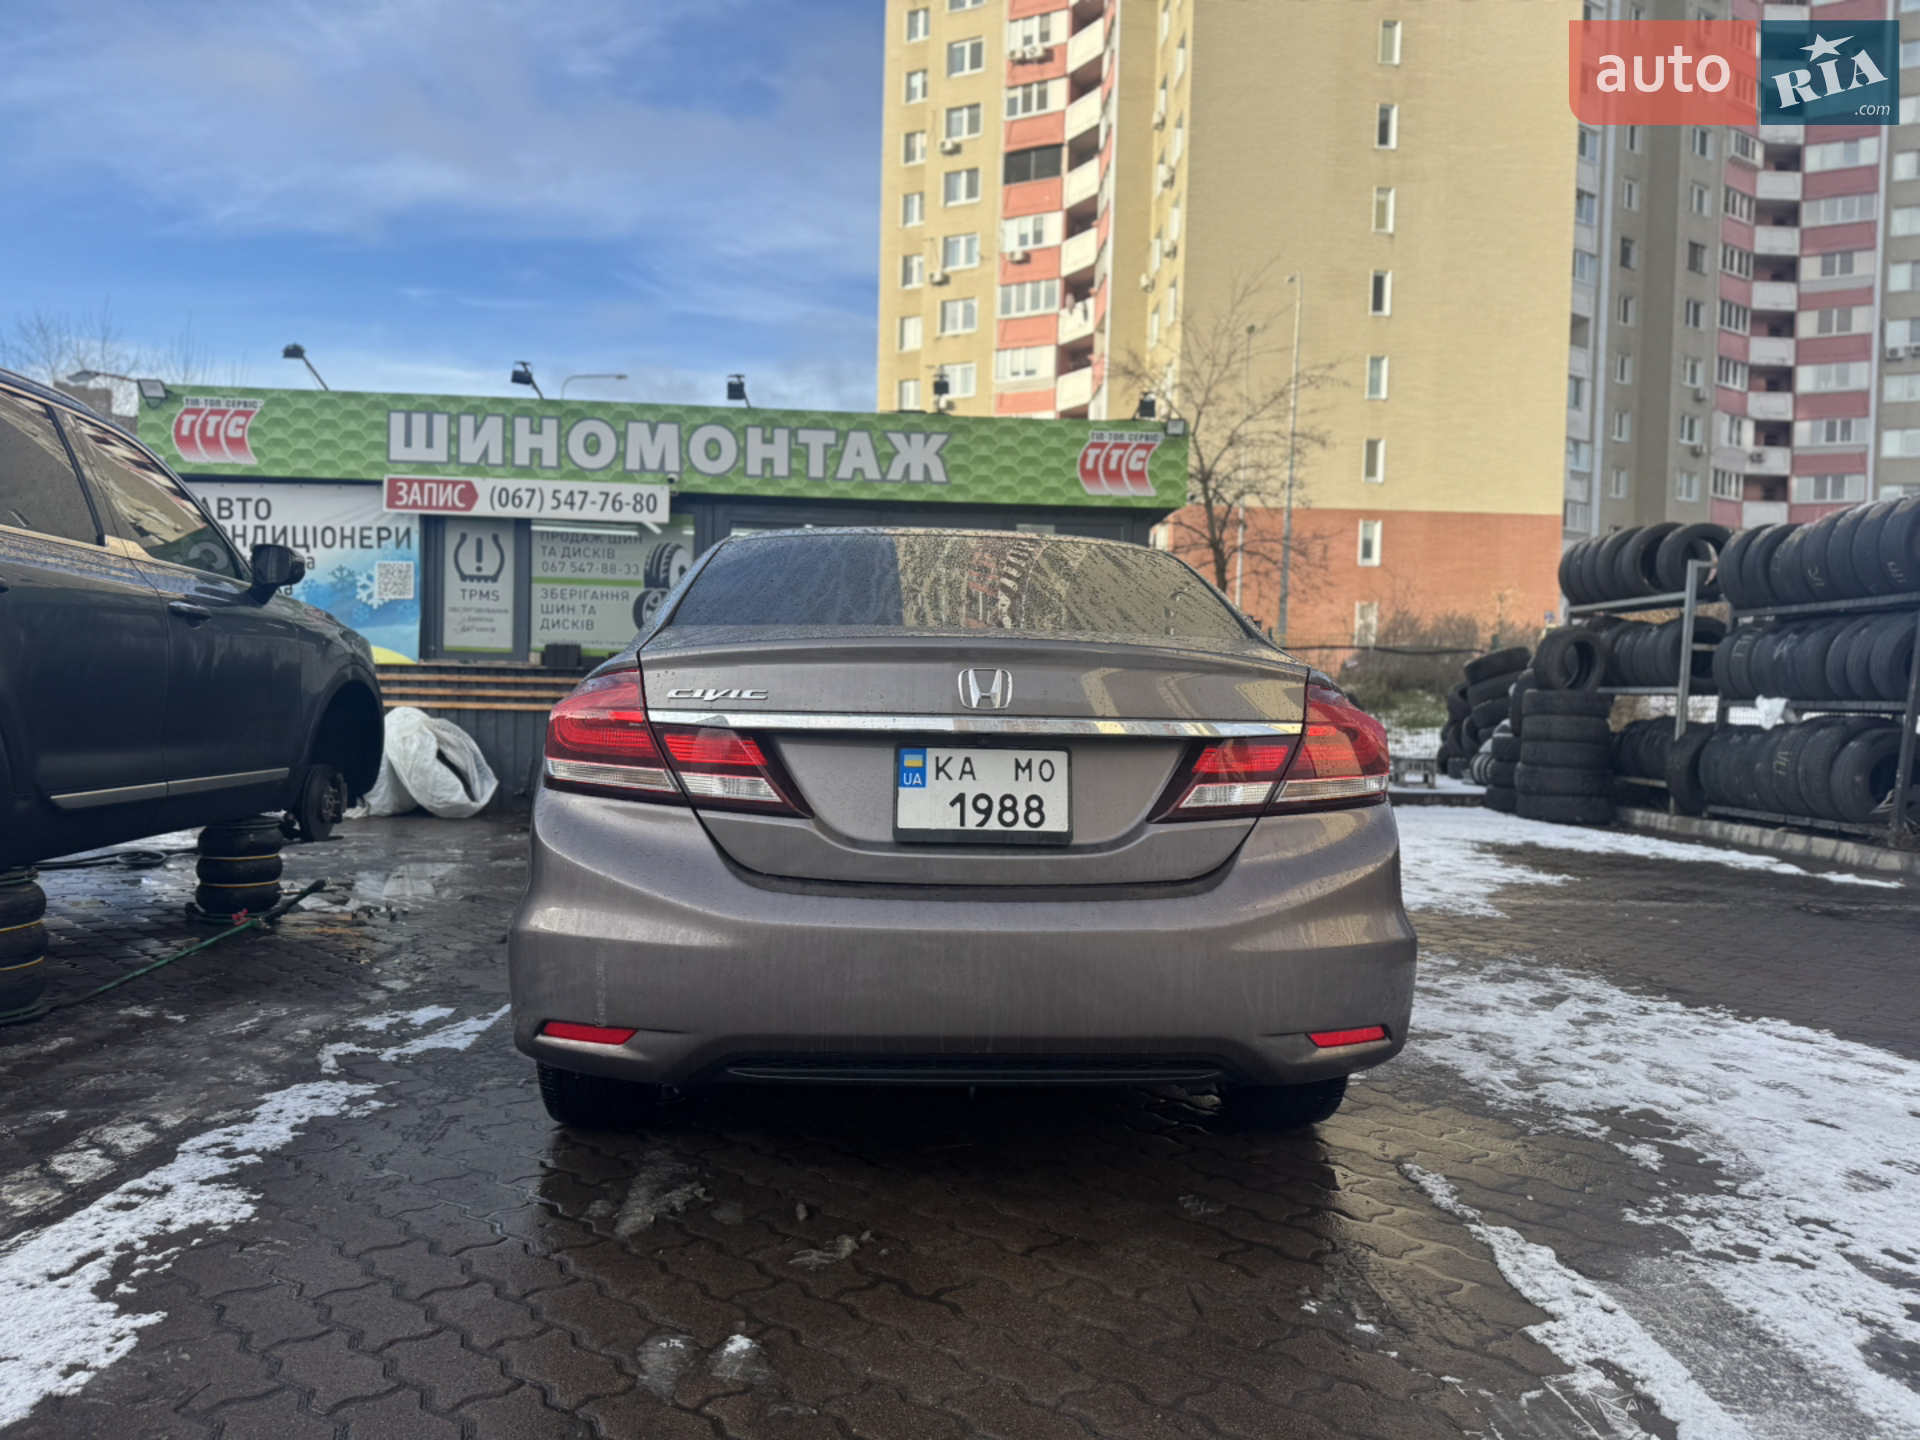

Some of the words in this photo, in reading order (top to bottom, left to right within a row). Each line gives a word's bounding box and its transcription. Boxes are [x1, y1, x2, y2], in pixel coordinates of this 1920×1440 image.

[184, 398, 222, 407] ТІП-ТОП
[225, 399, 259, 409] СЕРВІС
[181, 414, 247, 438] ТТС
[1091, 432, 1125, 441] ТІП-ТОП
[1128, 433, 1159, 442] СЕРВІС
[387, 409, 951, 485] ШИНОМОНТАЖ
[1085, 448, 1148, 471] ТТС
[395, 482, 467, 508] ЗАПИС
[489, 485, 545, 513] (067)
[550, 489, 658, 514] 547-76-80
[539, 531, 605, 544] ПРОДАЖ
[608, 534, 643, 545] ШИН
[540, 545, 557, 557] ТА
[561, 546, 615, 560] ДИСКІВ
[541, 561, 566, 573] 067
[570, 562, 640, 576] 547-88-33
[460, 588, 500, 602] TPMS
[540, 588, 630, 602] ЗБЕРІГАННЯ
[540, 603, 576, 616] ШИН
[580, 605, 597, 616] ТА
[540, 618, 595, 632] ДИСКІВ
[666, 688, 769, 702] CIVIC
[935, 756, 976, 781] KA
[903, 772, 923, 786] UA
[949, 792, 1046, 829] 1988
